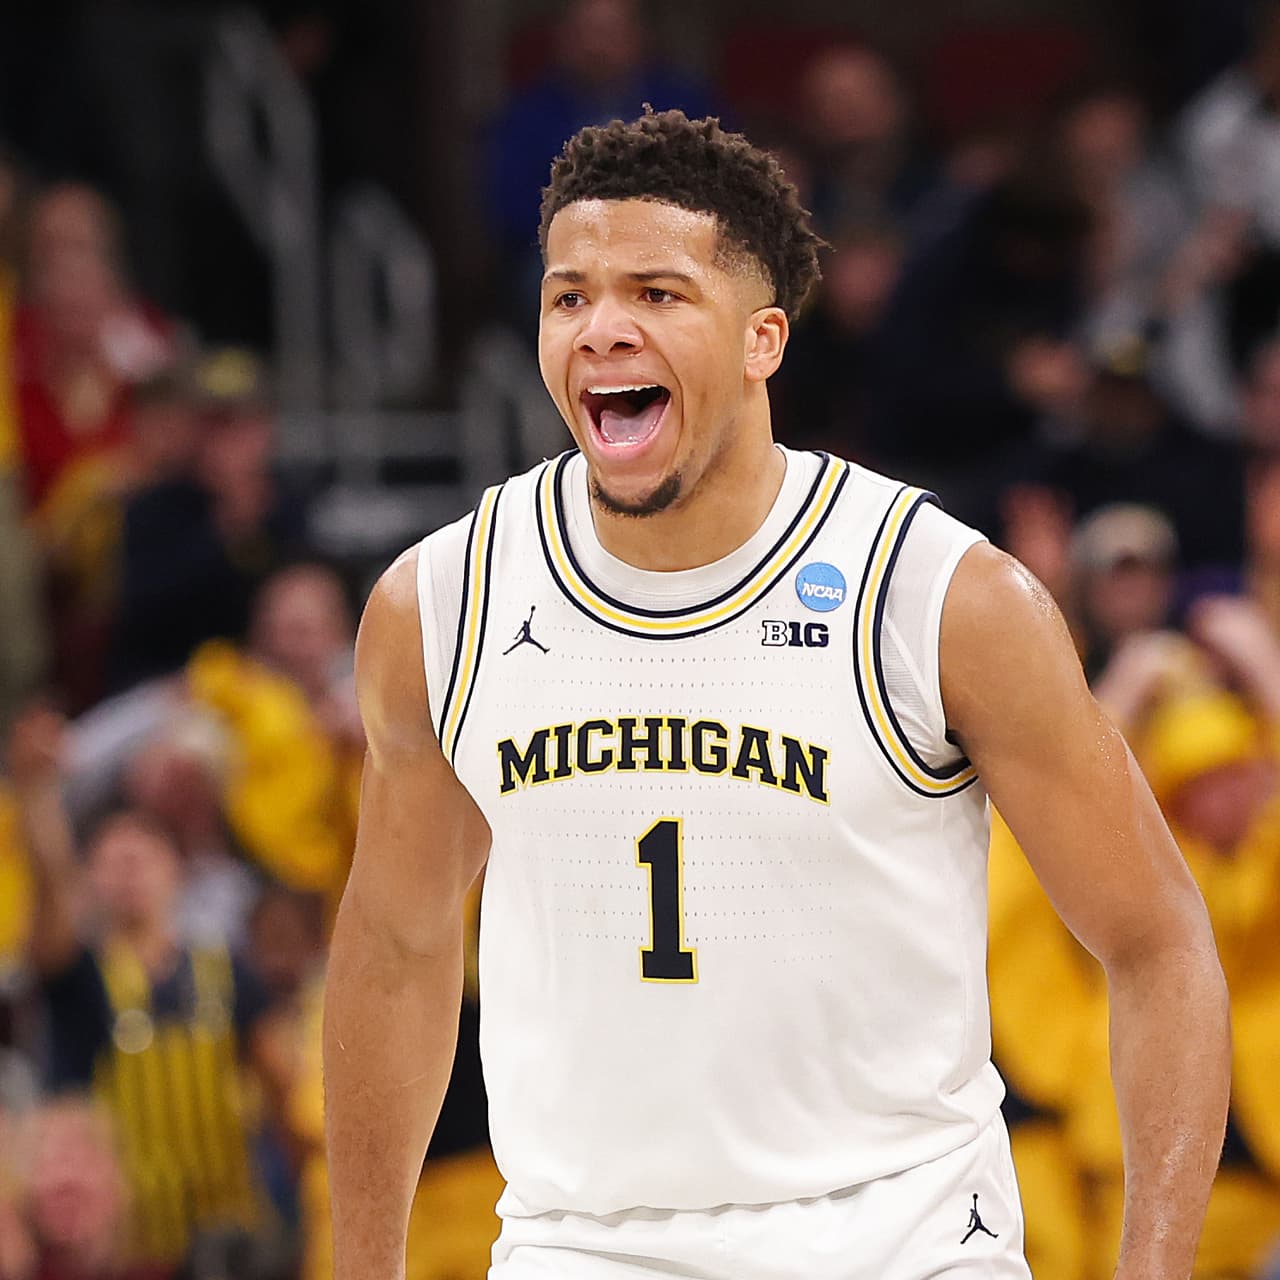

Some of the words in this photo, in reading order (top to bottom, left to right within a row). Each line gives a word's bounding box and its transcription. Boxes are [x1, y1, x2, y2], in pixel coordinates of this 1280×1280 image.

[802, 582, 843, 601] NCAA
[497, 715, 831, 807] MICHIGAN
[635, 817, 698, 984] 1
